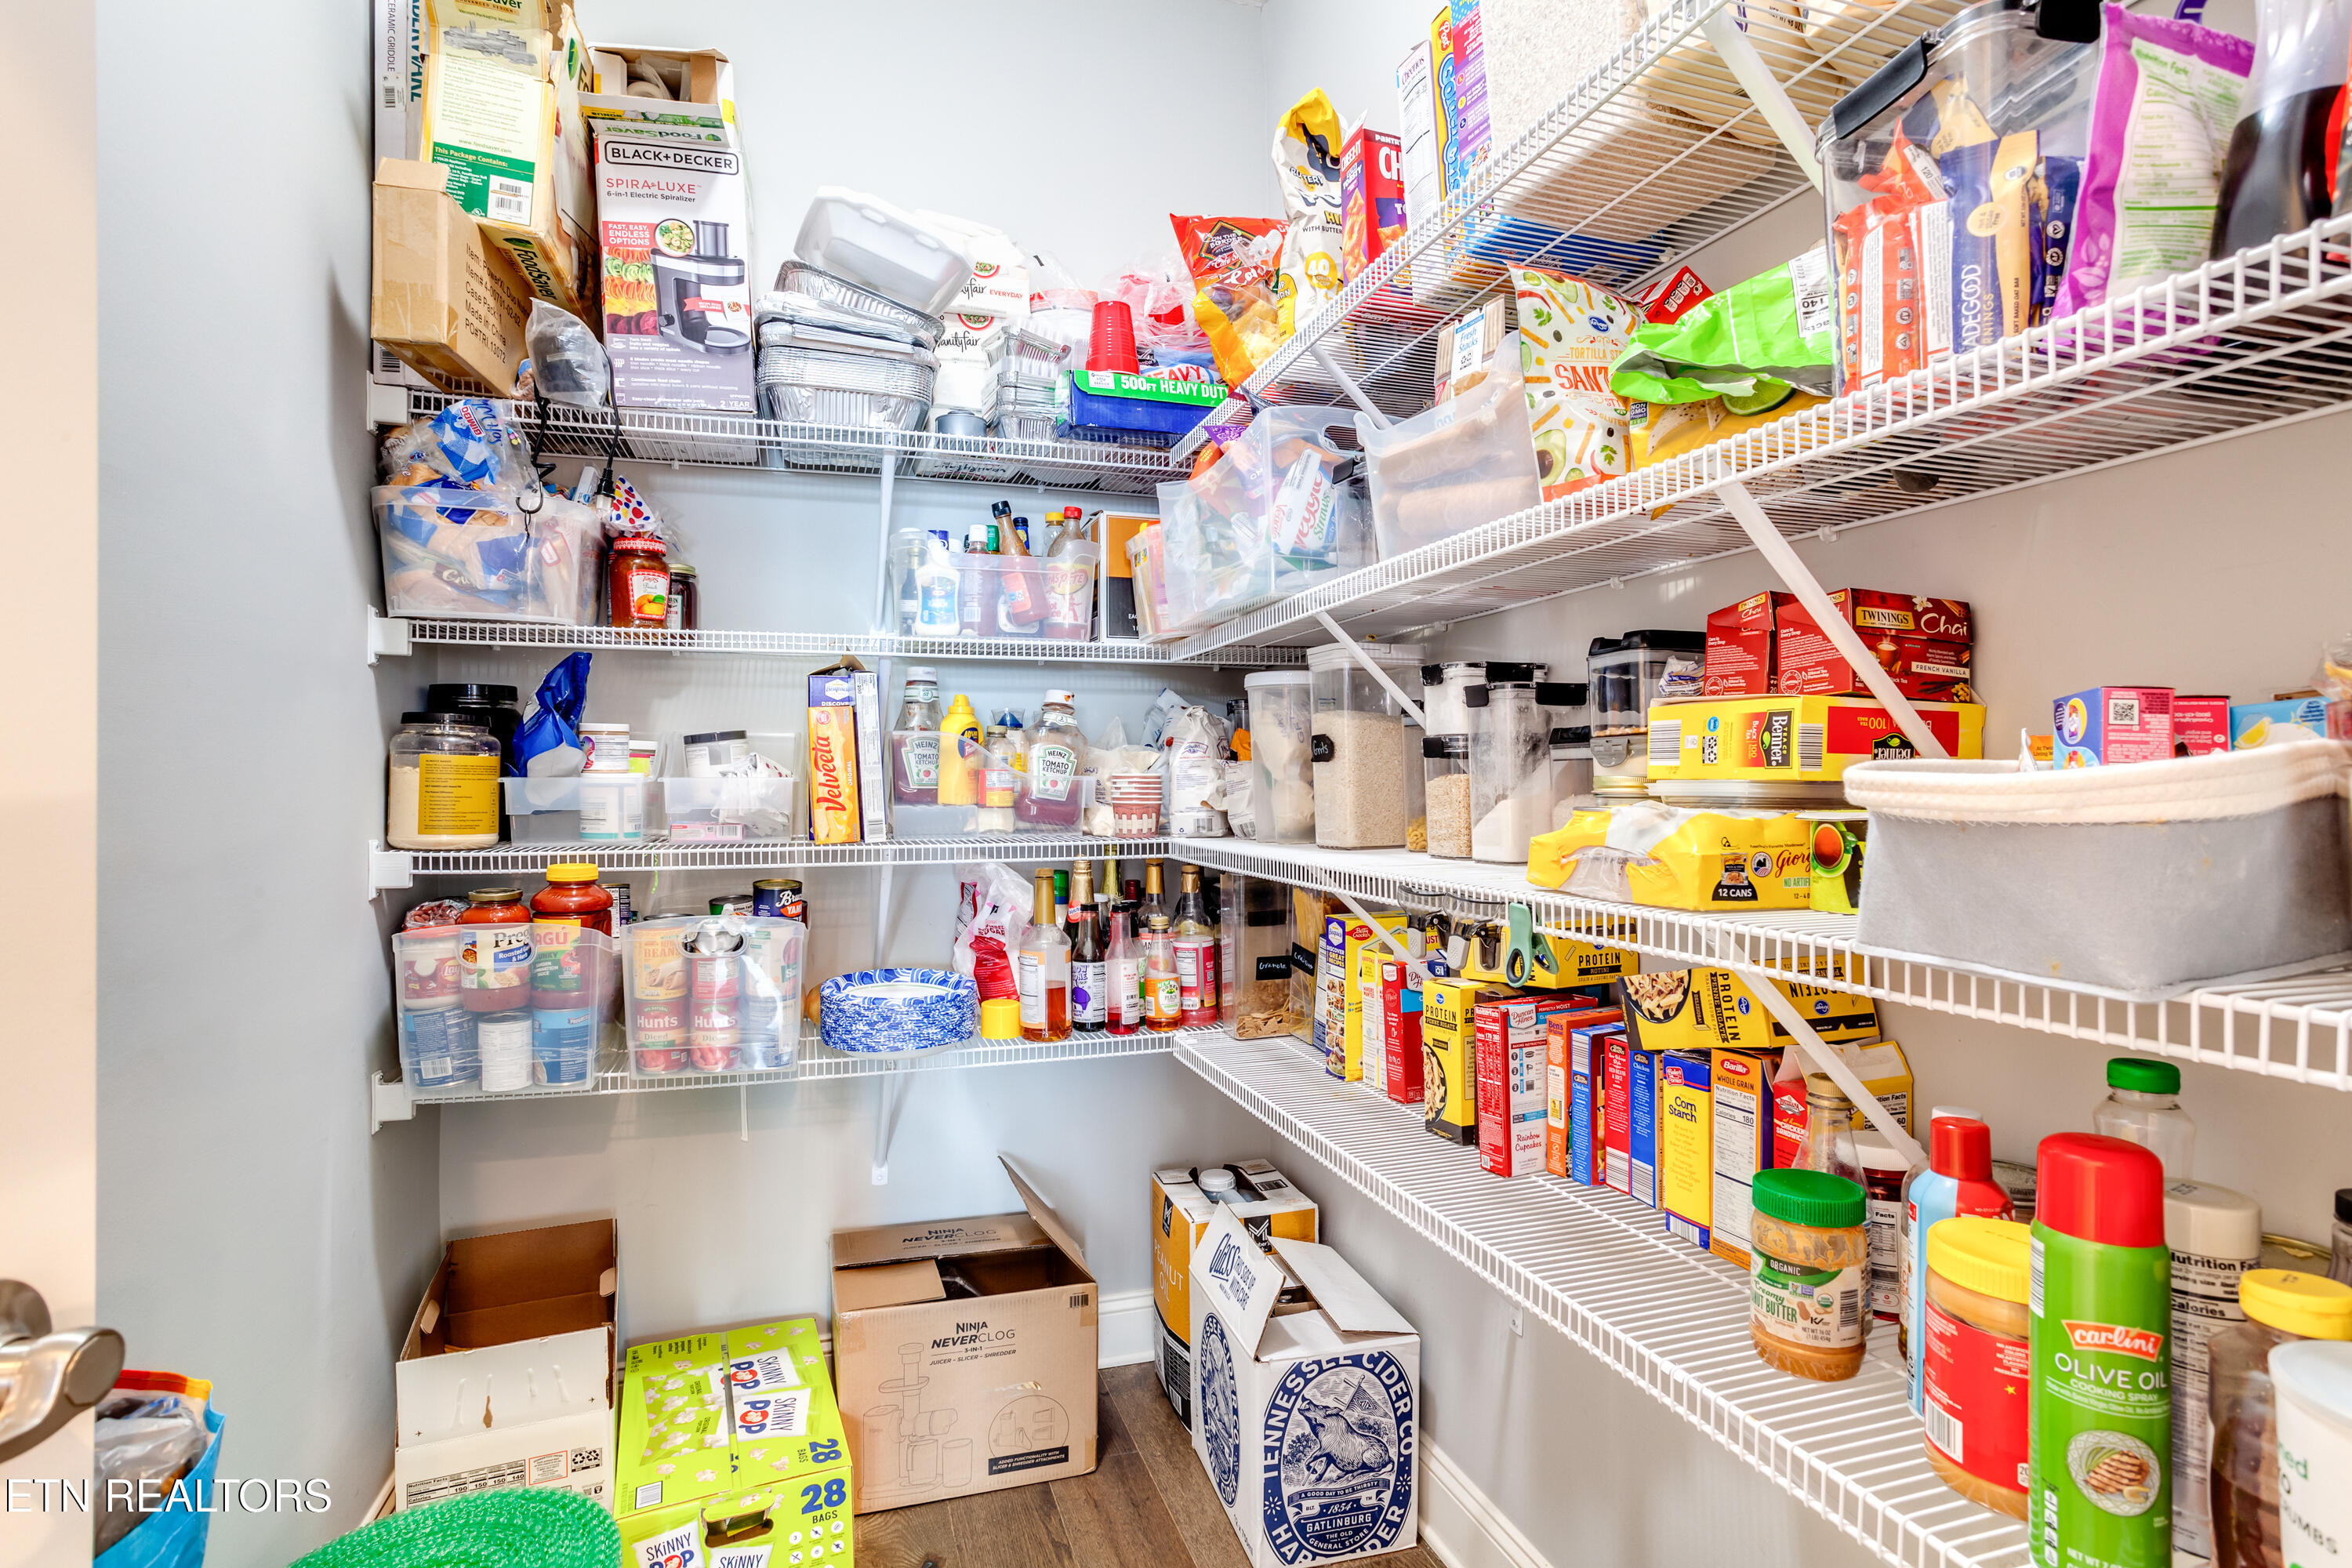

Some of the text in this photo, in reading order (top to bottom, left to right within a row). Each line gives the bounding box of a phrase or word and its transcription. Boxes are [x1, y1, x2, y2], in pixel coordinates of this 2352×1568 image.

[1439, 20, 1450, 49] Post
[387, 36, 396, 72] GRIDDLE
[1401, 55, 1425, 86] Cheerios
[604, 125, 702, 141] FoodSaver
[435, 147, 509, 167] This Package Contains:
[611, 147, 732, 169] BLACK+DECKER
[660, 193, 695, 202] Spiralizer
[608, 230, 650, 238] ENDLESS
[608, 237, 650, 246] OPTIONS
[466, 242, 482, 269] Item:
[466, 262, 485, 287] Item#
[513, 248, 558, 300] FoodSaver
[1308, 259, 1330, 274] 40
[465, 281, 482, 302] Case
[989, 289, 1023, 299] EVERYDAY
[1962, 264, 1982, 347] ADEGOOD
[465, 299, 507, 347] Made China
[1588, 317, 1610, 332] Kroger
[1460, 326, 1477, 343] Fresh
[1457, 336, 1479, 354] Stacks
[1570, 347, 1607, 361] TORTILLA
[1160, 379, 1198, 397] HEAVY
[461, 406, 483, 436] BIMBO
[1741, 606, 1762, 619] Chai
[1860, 608, 1910, 625] TWININGS
[1920, 612, 1968, 637] Chai
[1915, 664, 1967, 676] FRENCH VANILLA
[1751, 720, 1759, 740] BLACK
[1867, 717, 1887, 730] 100
[914, 740, 938, 750] HEINZ
[1771, 714, 1789, 760] Benner
[1047, 750, 1068, 760] HEINZ
[1749, 742, 1759, 759] 100
[811, 734, 848, 812] Velveeta
[1042, 759, 1070, 770] TOMATO
[1784, 878, 1792, 887] NO
[1718, 888, 1753, 898] 12 CANS
[499, 949, 523, 960] Roasted
[1329, 952, 1345, 962] GREAT
[1577, 952, 1622, 967] PROTEIN
[1258, 961, 1287, 971] Granola
[1425, 1004, 1457, 1022] PROTEIN
[1511, 1008, 1535, 1021] Duncan
[1718, 972, 1741, 1042] PROTEIN
[1548, 1019, 1564, 1032] Ben's
[1548, 1028, 1564, 1036] Original
[1633, 1062, 1650, 1073] Chicken
[1722, 1061, 1748, 1074] Barilla
[1573, 1083, 1589, 1092] Chicken
[1716, 1073, 1755, 1091] WHOLE GRAIN
[1715, 1085, 1755, 1102] Nutrition Facts
[1890, 1092, 1907, 1101] Facts
[1674, 1095, 1697, 1113] Corn
[1668, 1105, 1697, 1123] Starch
[1715, 1108, 1755, 1125] Calories 180
[1516, 1131, 1541, 1142] Rainbow
[1776, 1127, 1804, 1142] SANDWIC
[1515, 1141, 1542, 1153] Cupcakes
[927, 1227, 964, 1236] NINJA
[1208, 1232, 1241, 1277] Glass
[1153, 1239, 1184, 1291] PEANUT
[1769, 1258, 1802, 1276] ORGANIC
[1160, 1271, 1170, 1303] OIL
[1754, 1279, 1786, 1305] Creamy
[1766, 1298, 1798, 1325] BUTTER
[956, 1321, 989, 1334] NINJA
[931, 1328, 1017, 1349] NEVERCLOG
[929, 1348, 1017, 1366] JUICER SLICER SHREDDER
[964, 1345, 982, 1354] 3-IN-1
[2054, 1352, 2169, 1391] OLIVE OIL
[2069, 1377, 2127, 1401] COOKING
[2128, 1392, 2158, 1402] SPRAY
[738, 1399, 771, 1435] POP
[1263, 1350, 1413, 1479] TENNESSEE CIDER CO.
[797, 1449, 808, 1464] BAGS
[808, 1438, 843, 1465] 28
[1014, 1453, 1048, 1462] FUNCTIONALITY
[1011, 1459, 1036, 1468] SHREDDER
[1035, 1454, 1065, 1463] ATTACHMENTS
[408, 1479, 436, 1489] Nutrition
[1354, 1480, 1379, 1493] THIRSTY
[800, 1477, 848, 1515] 28
[811, 1509, 838, 1524] BAGS
[1327, 1502, 1352, 1515] 1854
[1306, 1513, 1372, 1533] GATLINBURG
[1308, 1528, 1370, 1550] GENERAL STORE
[1340, 1530, 1353, 1539] OLD
